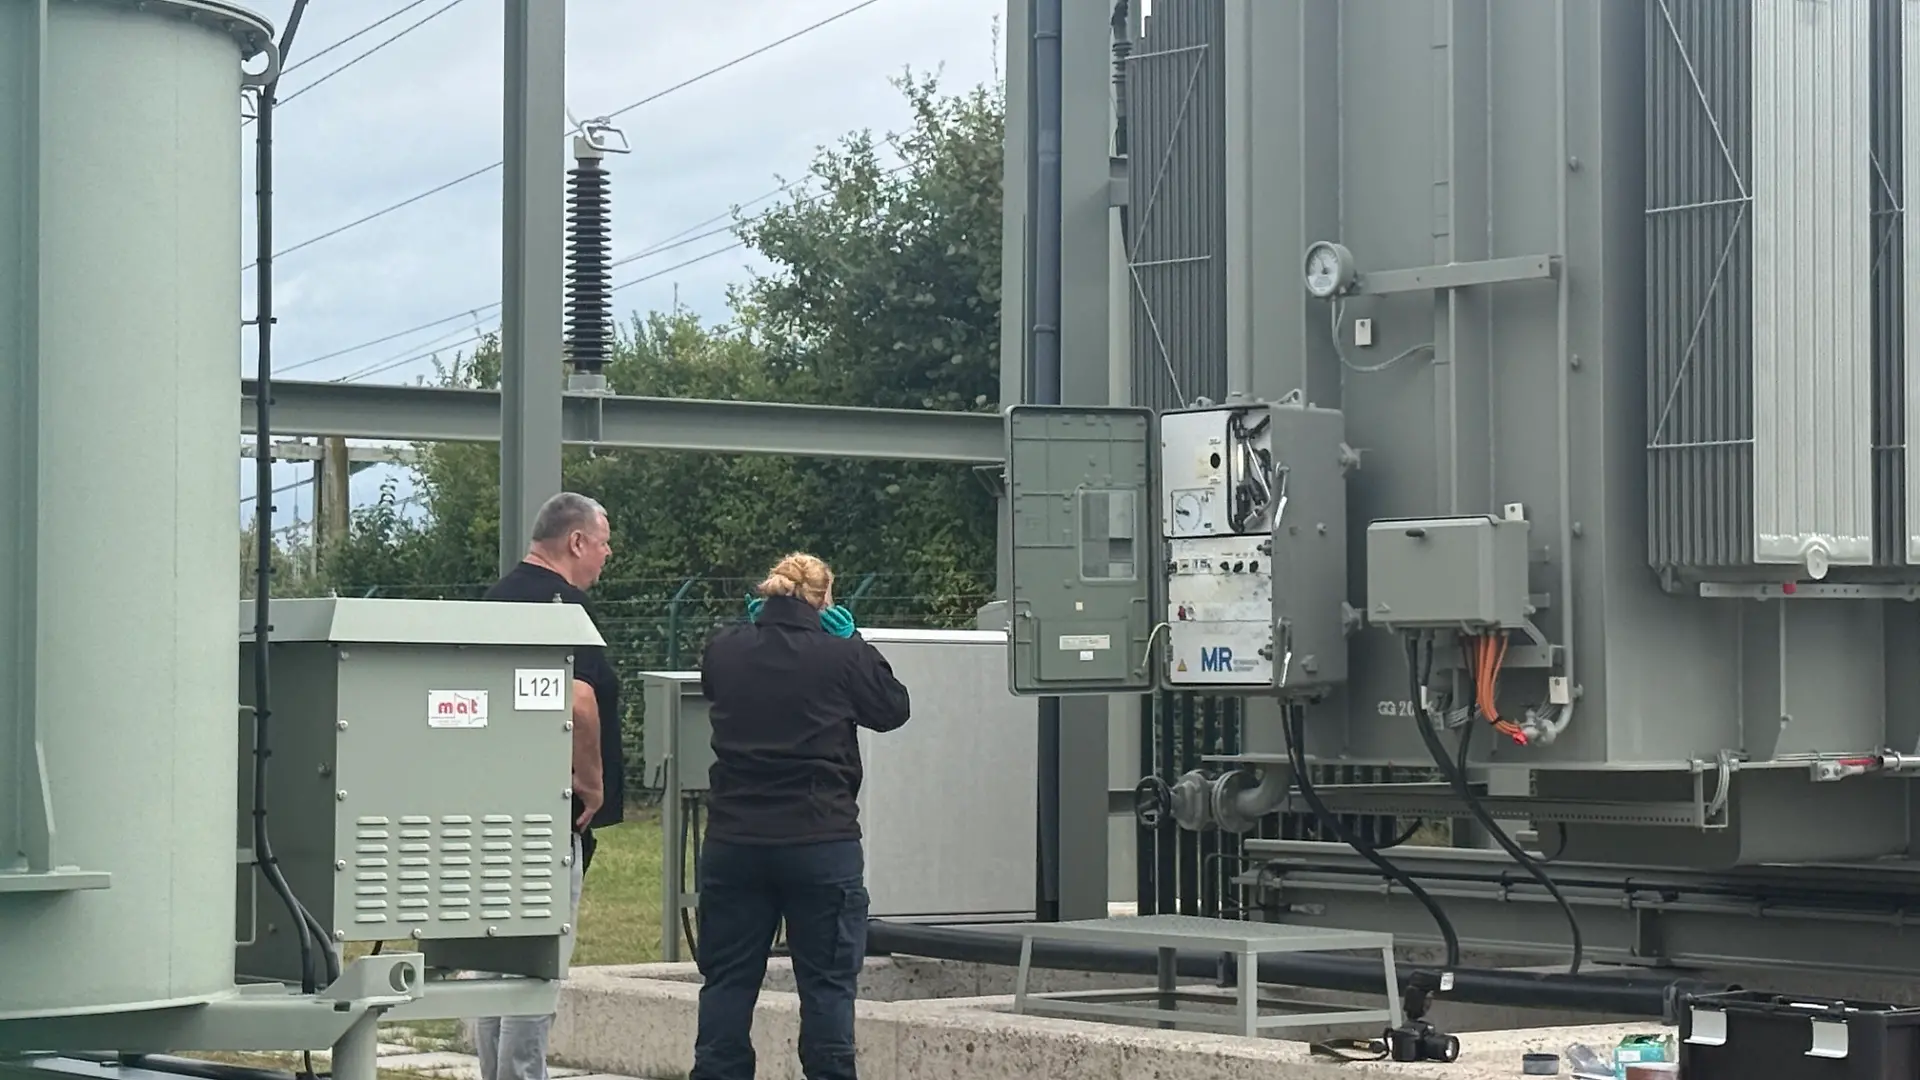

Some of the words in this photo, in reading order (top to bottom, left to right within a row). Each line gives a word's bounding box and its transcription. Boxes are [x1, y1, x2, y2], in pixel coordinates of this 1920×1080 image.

[1201, 646, 1233, 673] MR
[519, 677, 560, 697] L121
[438, 698, 478, 714] mat
